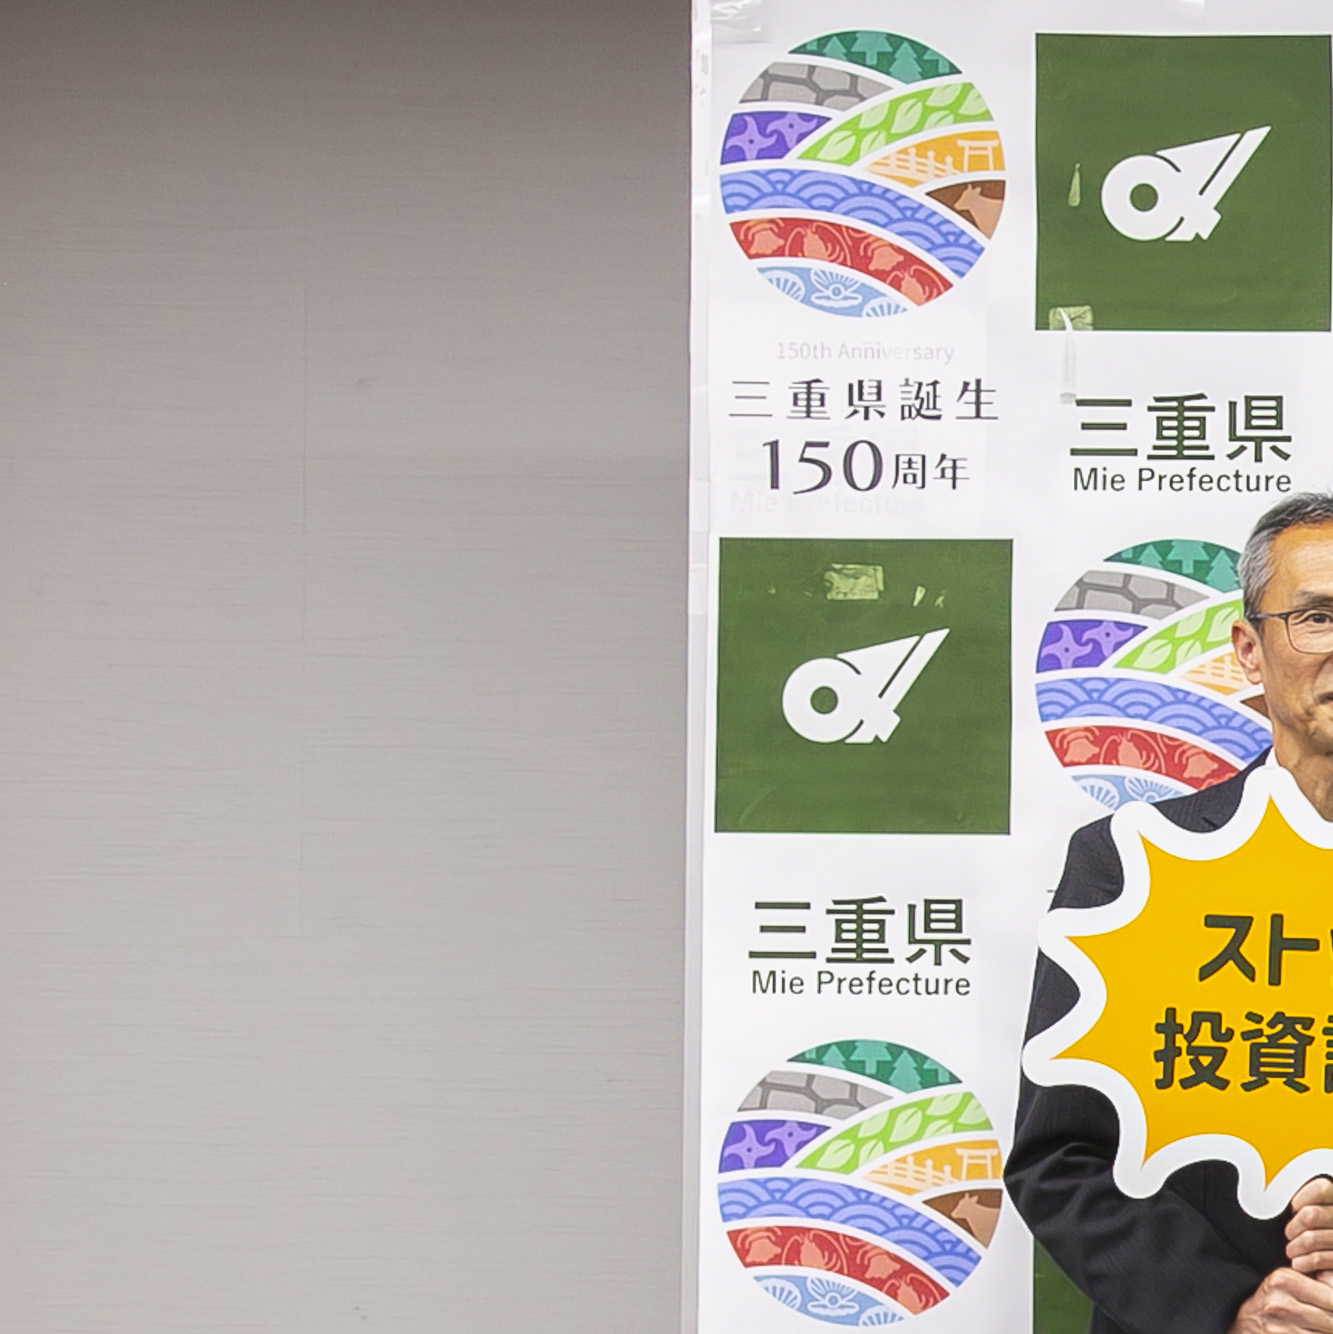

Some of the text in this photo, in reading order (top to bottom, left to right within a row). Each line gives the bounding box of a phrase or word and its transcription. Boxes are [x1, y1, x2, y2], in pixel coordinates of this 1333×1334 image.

[778, 342, 831, 360] 150th
[730, 379, 998, 420] 三重県誕生
[1070, 393, 1292, 463] 三重県
[763, 440, 968, 494] 150周年
[1074, 467, 1291, 492] Mie Prefecture
[749, 896, 971, 965] 三重県
[753, 970, 970, 995] Mie Prefecture
